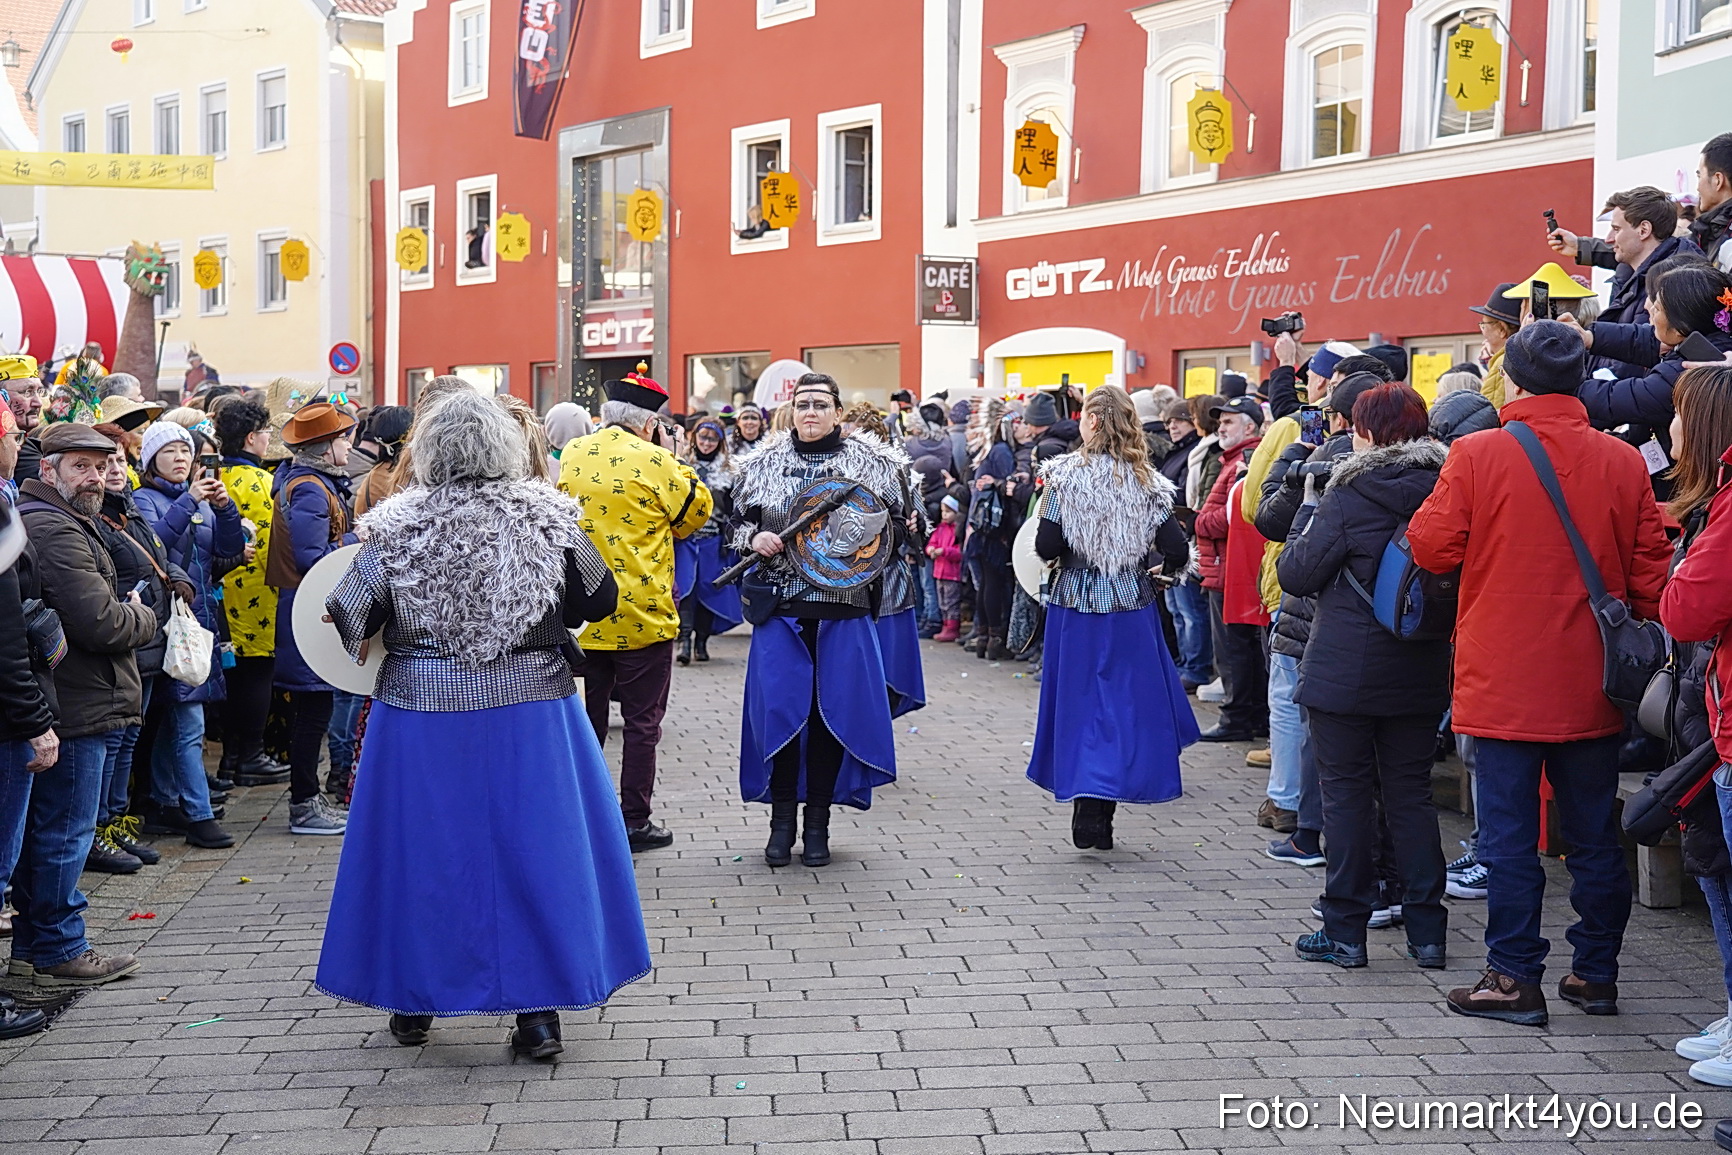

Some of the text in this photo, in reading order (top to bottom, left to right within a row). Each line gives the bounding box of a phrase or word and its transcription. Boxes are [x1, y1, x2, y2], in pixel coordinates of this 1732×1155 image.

[925, 264, 970, 288] CAFÉ
[1116, 245, 1164, 292] Mode
[1167, 255, 1219, 297] Genuss
[1223, 231, 1291, 279] Erlebnis
[1330, 224, 1451, 303] Erlebnis
[582, 318, 654, 347] GÖTZ
